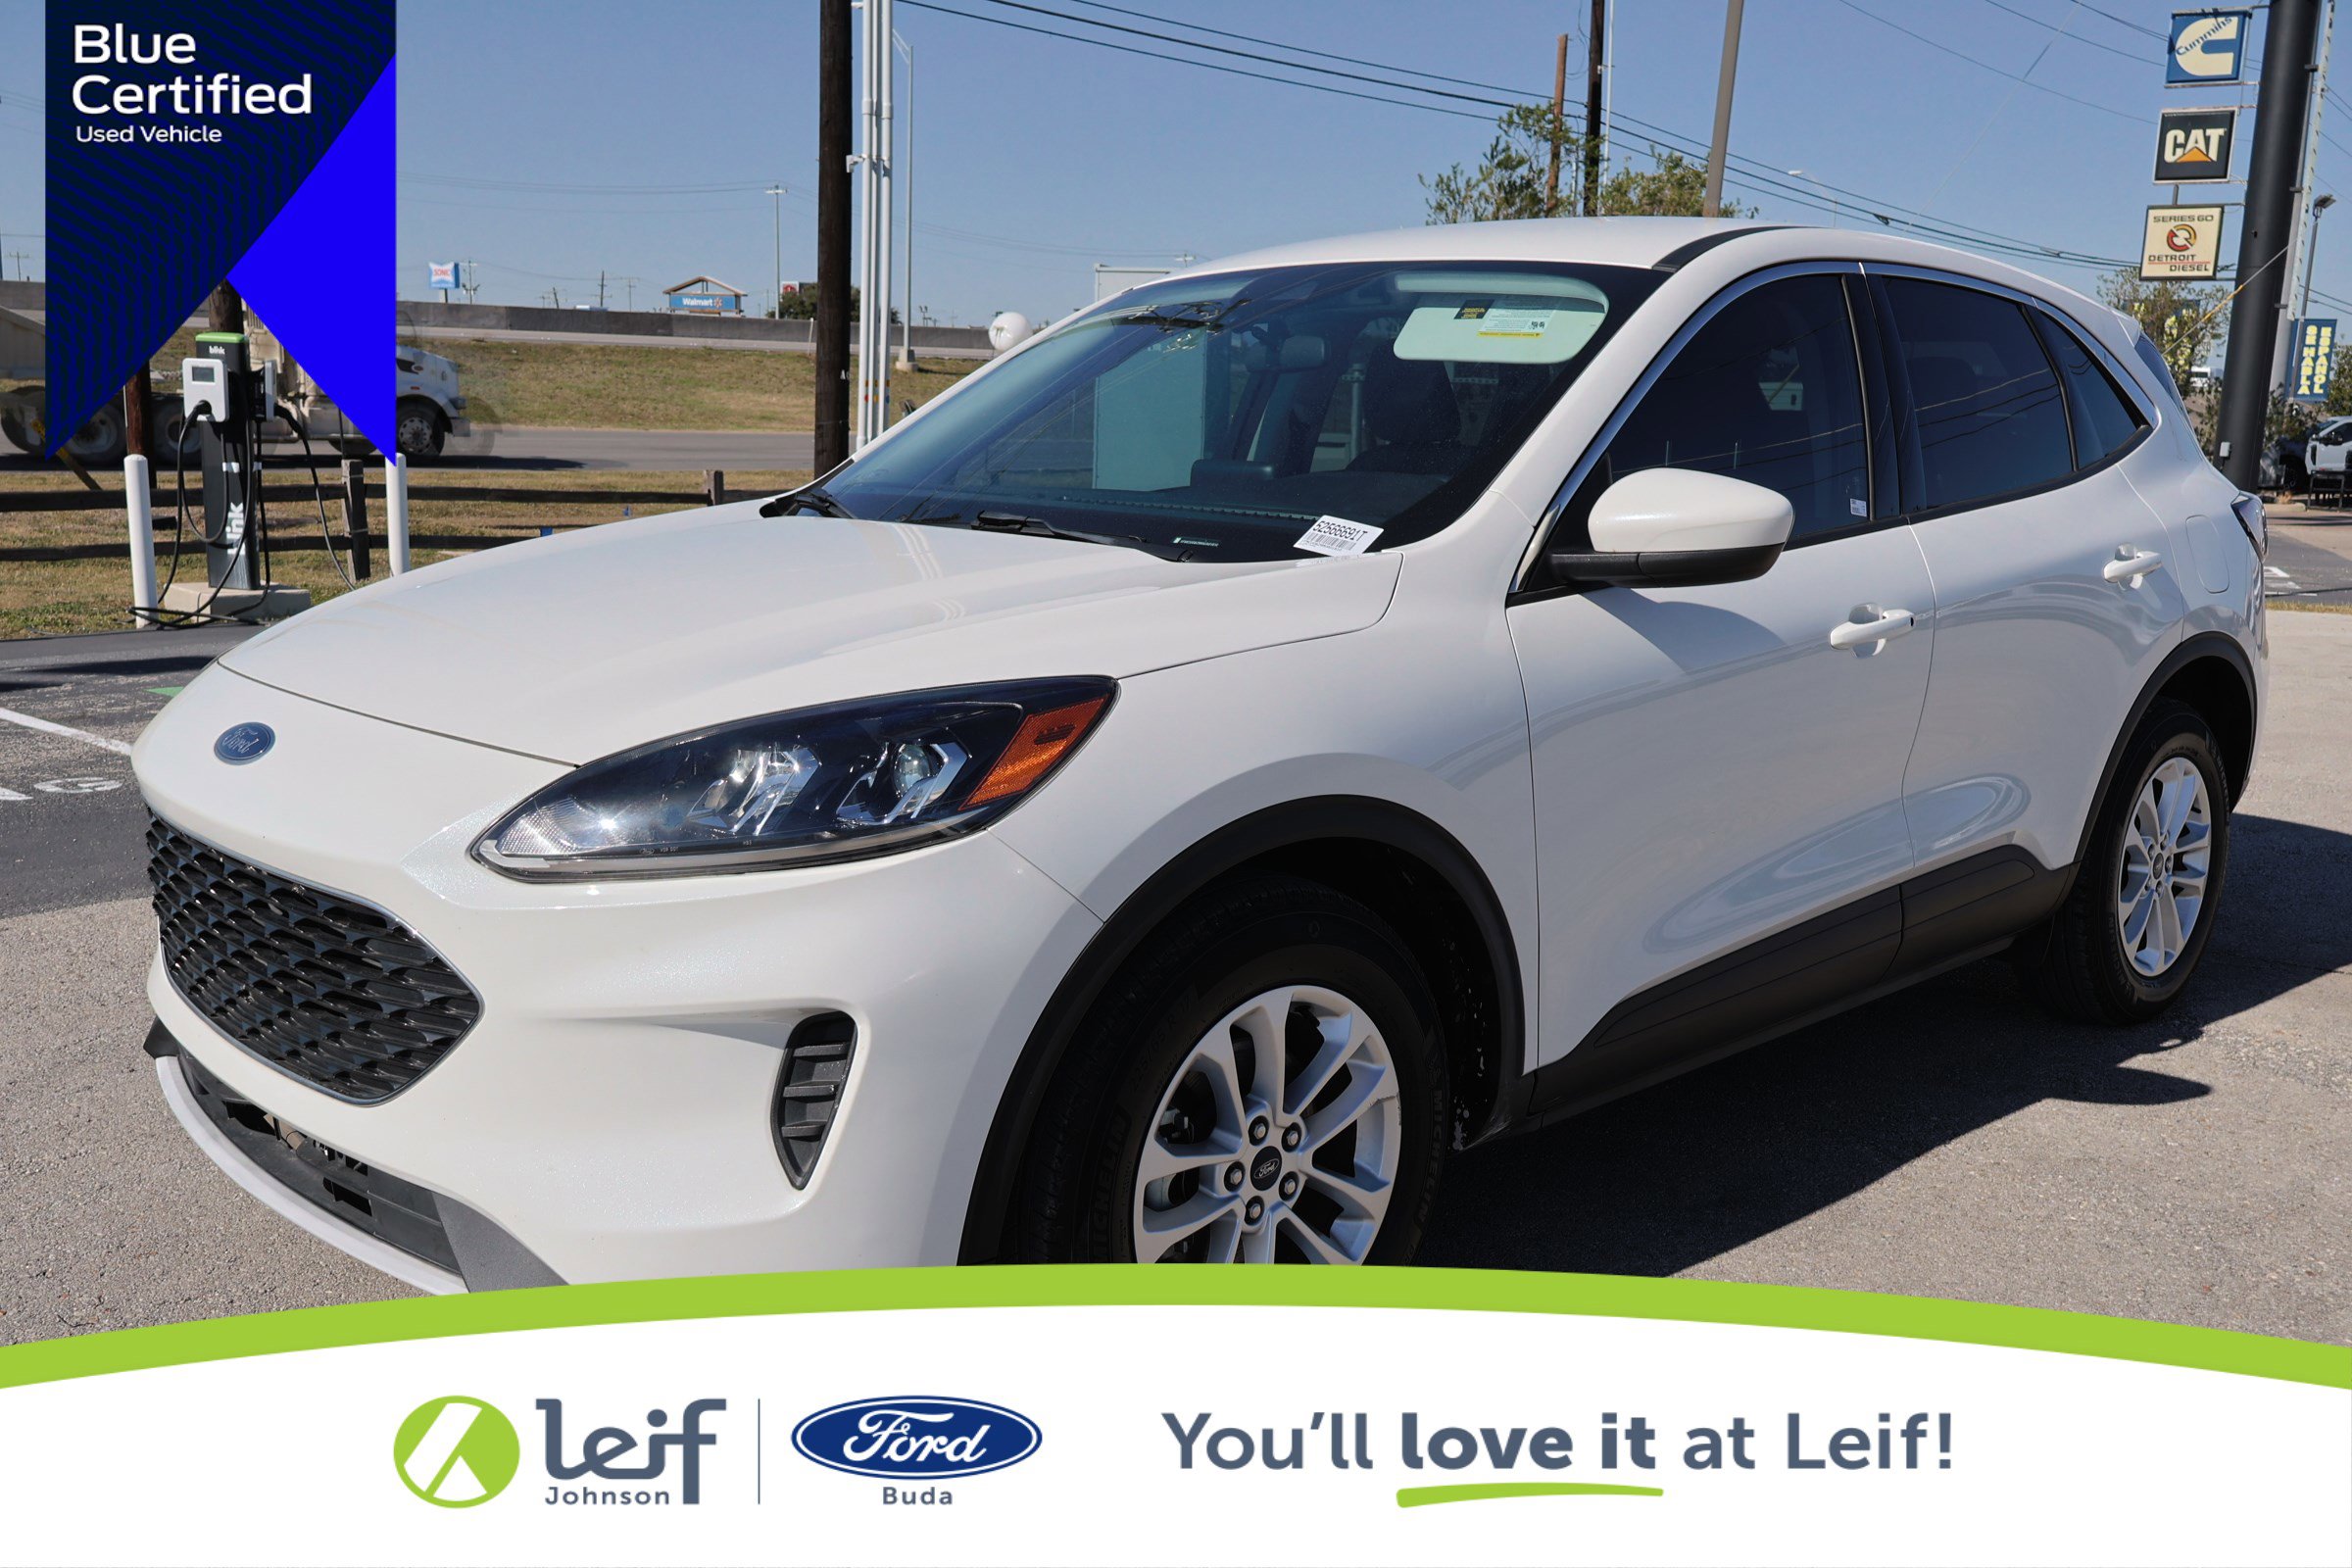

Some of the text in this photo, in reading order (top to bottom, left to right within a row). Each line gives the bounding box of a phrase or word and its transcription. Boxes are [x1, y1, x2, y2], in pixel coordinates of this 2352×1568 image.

[2175, 16, 2233, 57] Cummins
[2164, 127, 2226, 164] CAT
[2148, 254, 2197, 263] DETROIT
[2170, 264, 2210, 272] DIESEL
[682, 297, 713, 307] Walmart
[209, 345, 225, 355] blink
